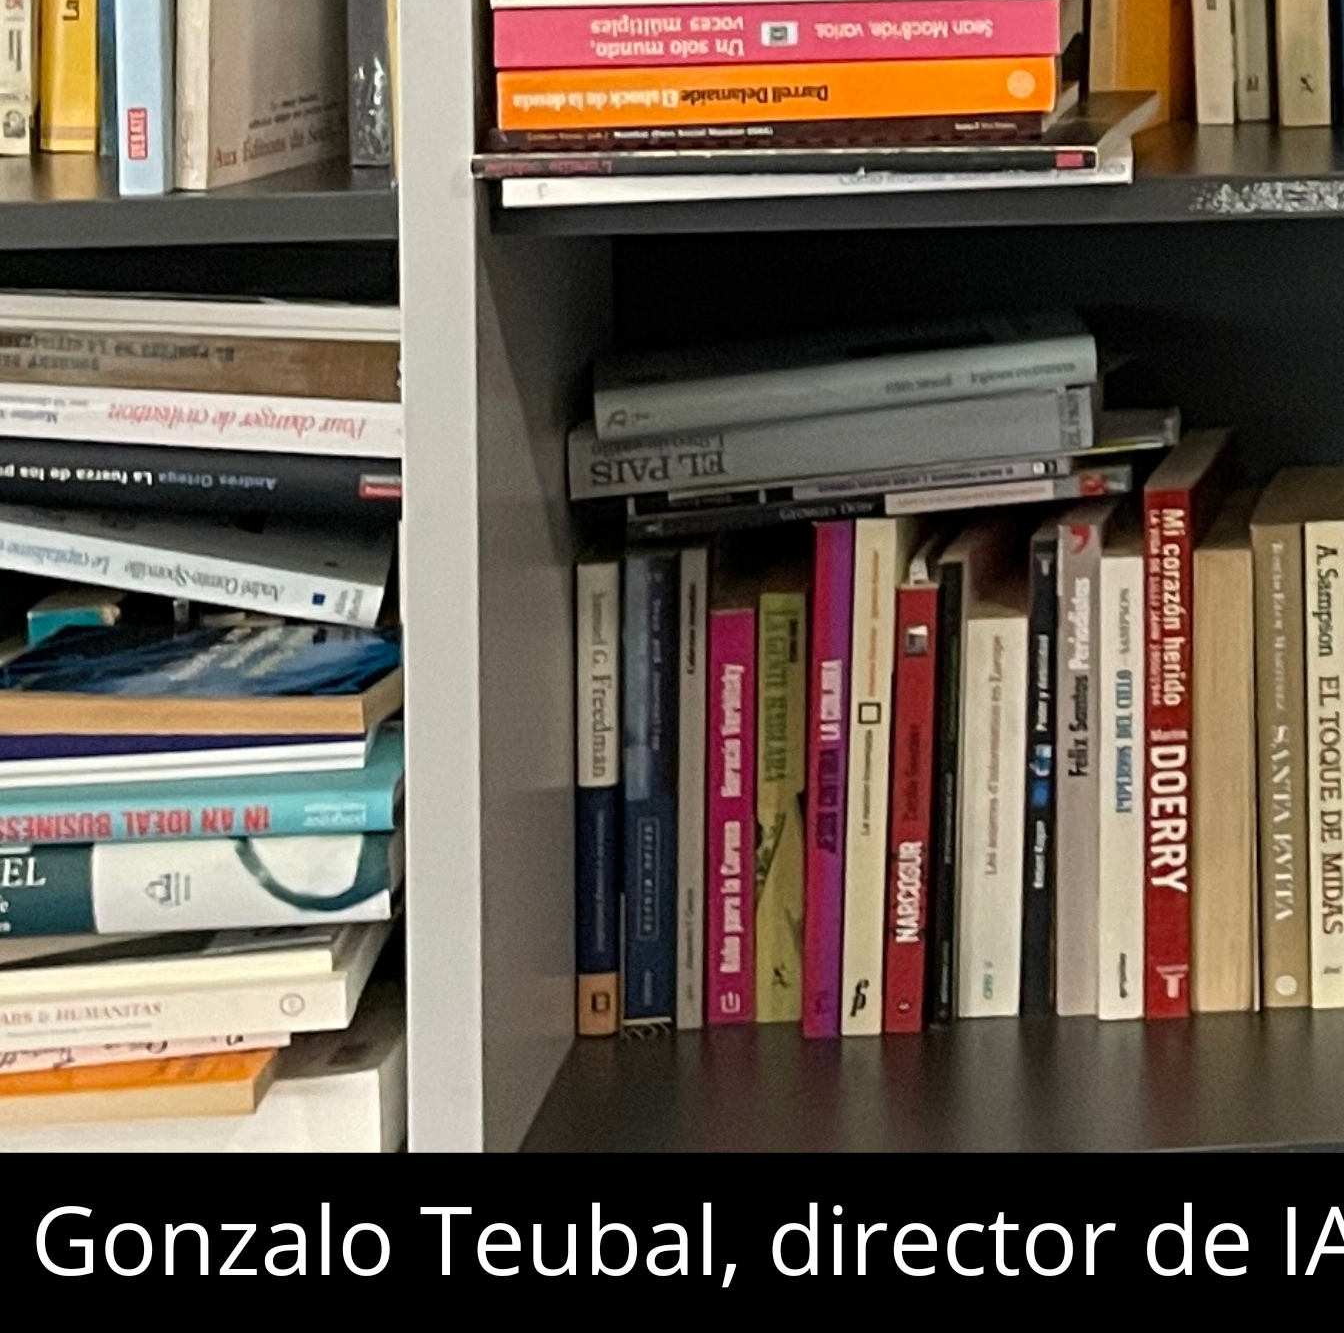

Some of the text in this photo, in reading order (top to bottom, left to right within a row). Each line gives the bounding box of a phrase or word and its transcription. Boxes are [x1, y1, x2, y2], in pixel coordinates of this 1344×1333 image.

[590, 14, 745, 38] voces múltiples
[588, 37, 745, 58] Un solo mundo,
[681, 85, 829, 105] Darrell Delamaide
[211, 409, 236, 432] de
[237, 407, 316, 439] changer
[322, 416, 367, 439] Pour
[132, 470, 153, 486] La
[589, 450, 727, 488] EL PAIS
[1161, 508, 1185, 706] Mi corazón herido
[1312, 543, 1339, 657] A. Sampson
[1066, 675, 1089, 732] Santos
[1149, 744, 1187, 892] DOERRY
[1270, 723, 1296, 921] SANTA EVITA
[1318, 674, 1344, 935] EL TOQUE DE MIDAS
